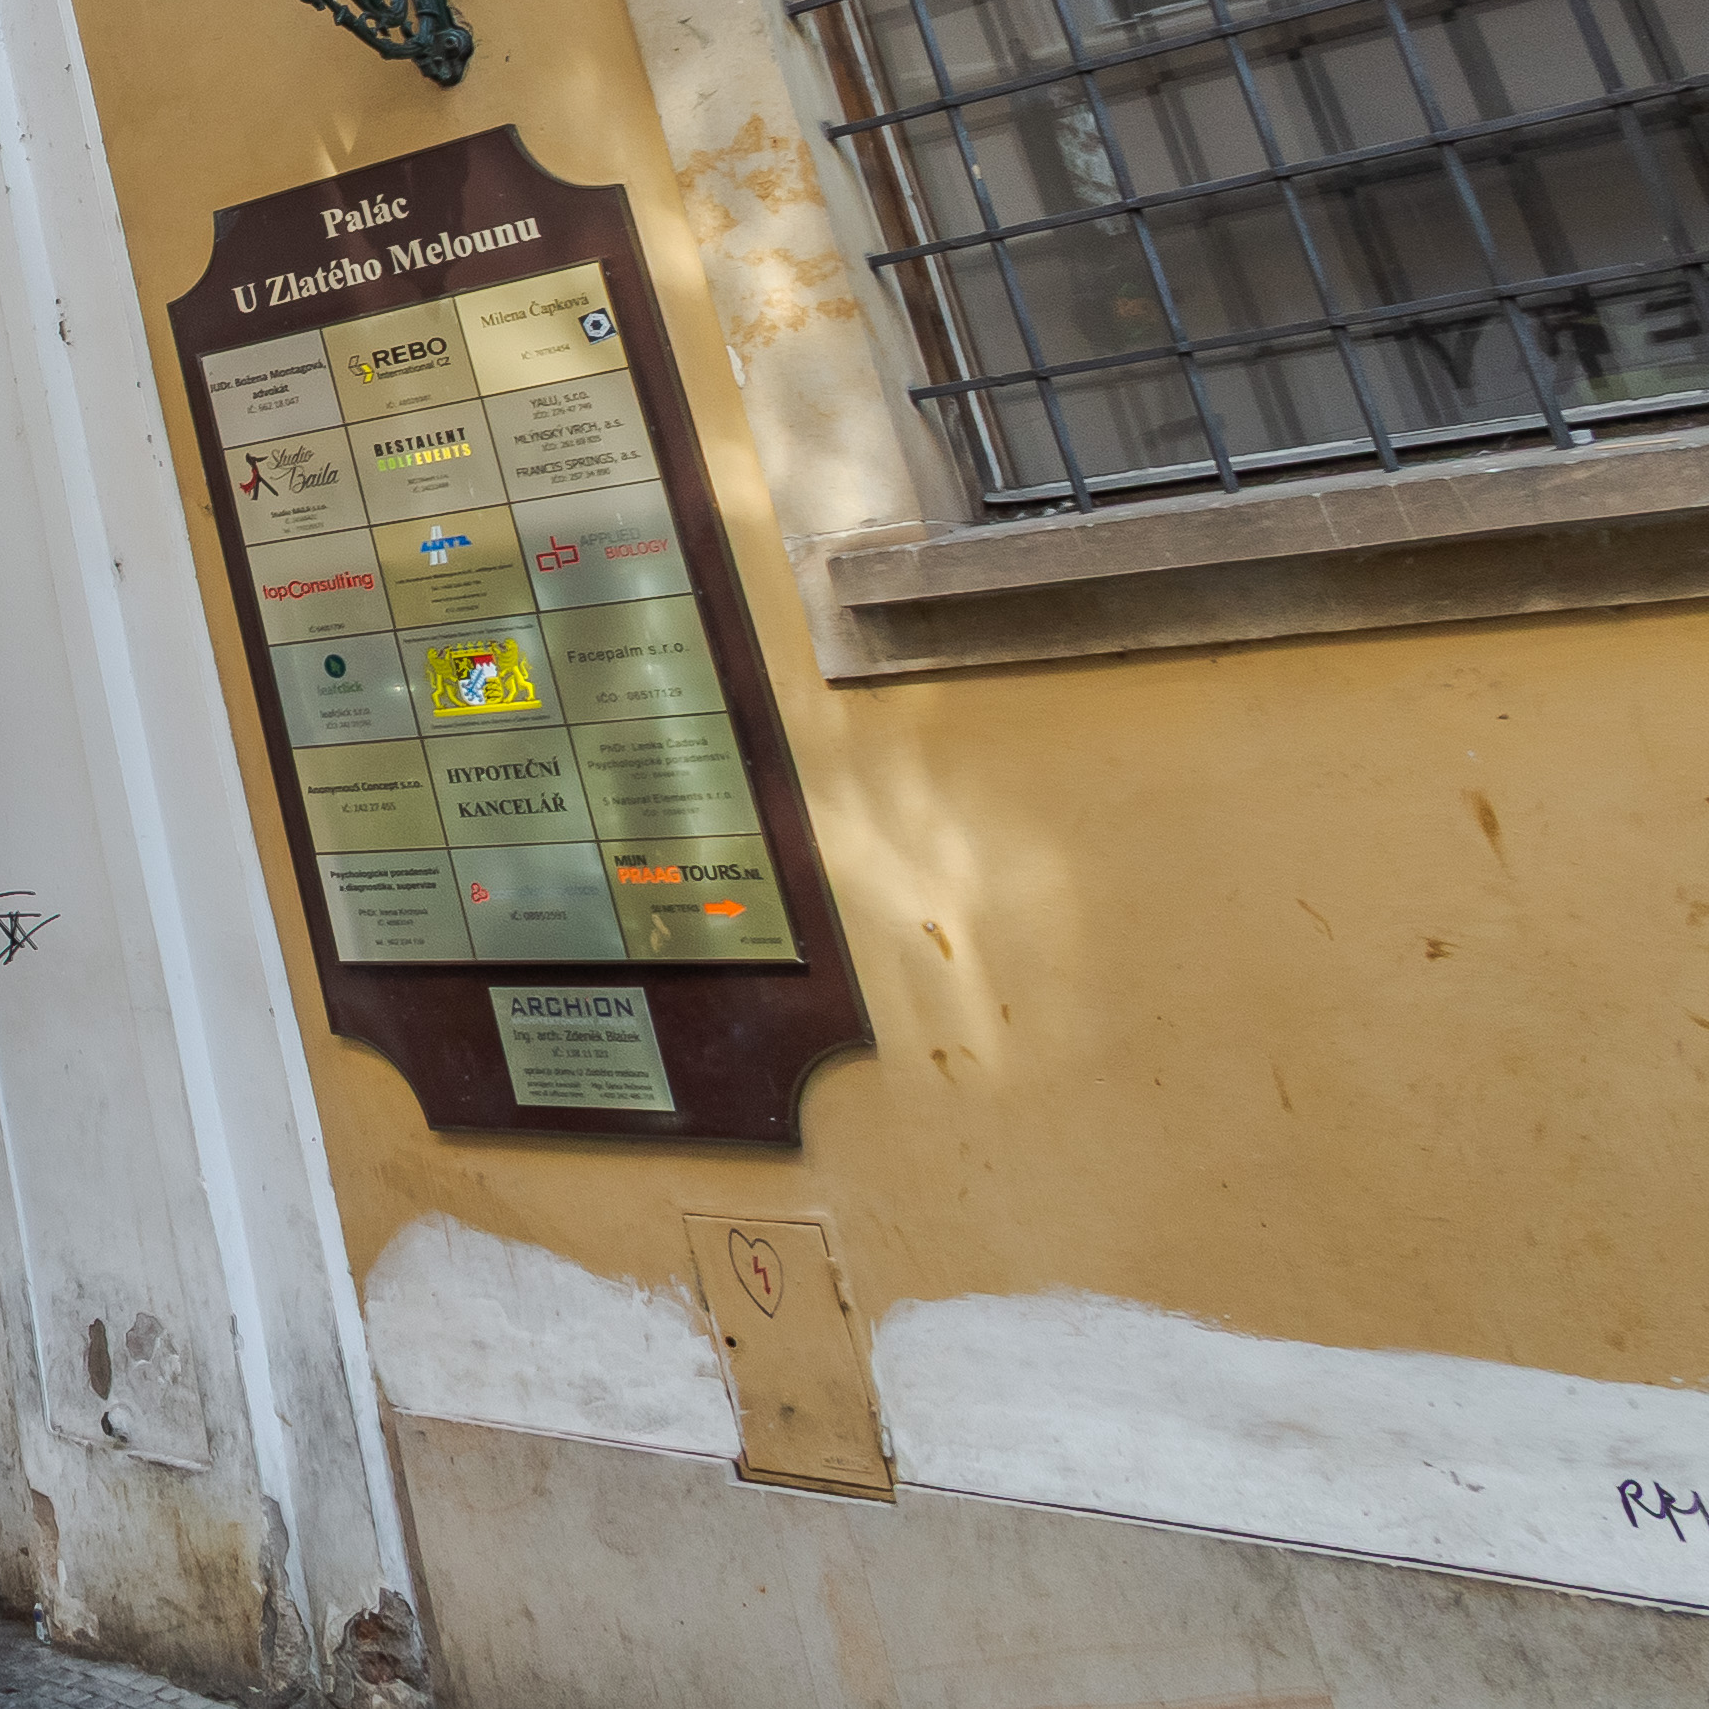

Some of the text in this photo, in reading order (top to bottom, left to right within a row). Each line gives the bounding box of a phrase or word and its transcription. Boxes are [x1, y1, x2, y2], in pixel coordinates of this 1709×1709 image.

[320, 193, 410, 239] Palác
[232, 217, 541, 313] U Zlatého Melounu
[480, 293, 589, 328] Milena Čapková
[372, 337, 447, 369] REBO
[235, 371, 268, 387] Božena
[376, 357, 451, 380] International CZ
[374, 427, 465, 457] BESTALENT
[267, 445, 315, 469] Studio
[516, 461, 563, 478] FRANCIS
[564, 452, 617, 472] SPRINGS,
[270, 462, 339, 493] Baila
[581, 527, 640, 546] APPLIED
[604, 539, 668, 559] BIOLOGY
[262, 571, 374, 601] topConsulting
[566, 642, 690, 664] Facepalm s.r.o.
[446, 755, 561, 784] HYPOTEČNÍ
[457, 792, 568, 818] KANCELÁŘ
